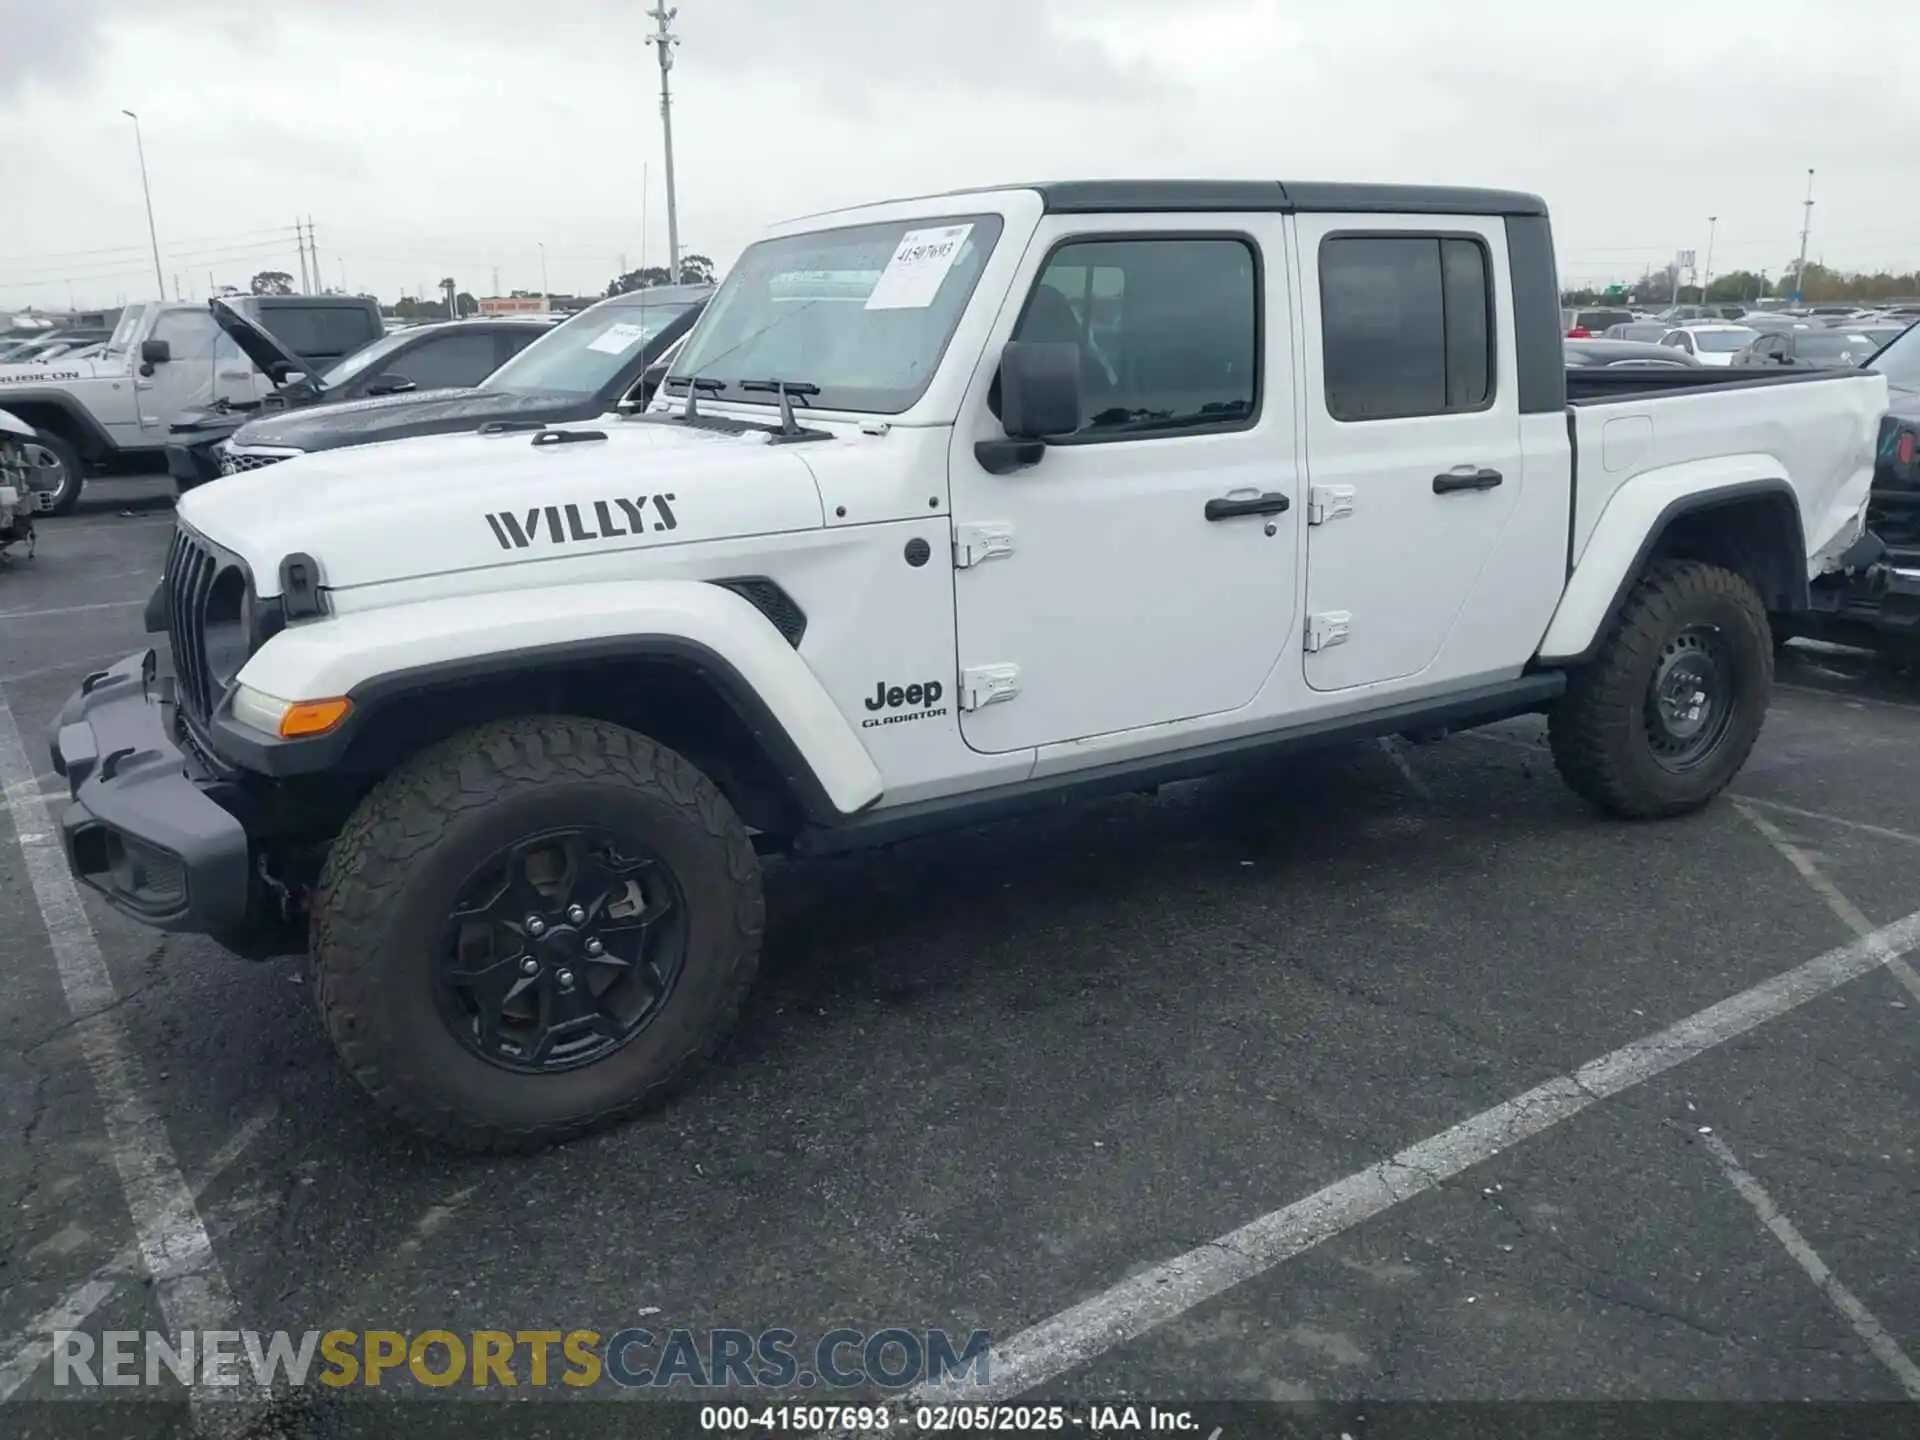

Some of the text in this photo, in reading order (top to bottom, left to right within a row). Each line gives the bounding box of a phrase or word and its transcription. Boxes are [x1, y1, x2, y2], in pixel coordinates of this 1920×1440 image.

[485, 493, 678, 549] WILLYS
[865, 681, 943, 711] Jeep
[862, 708, 947, 728] GLADIATOR
